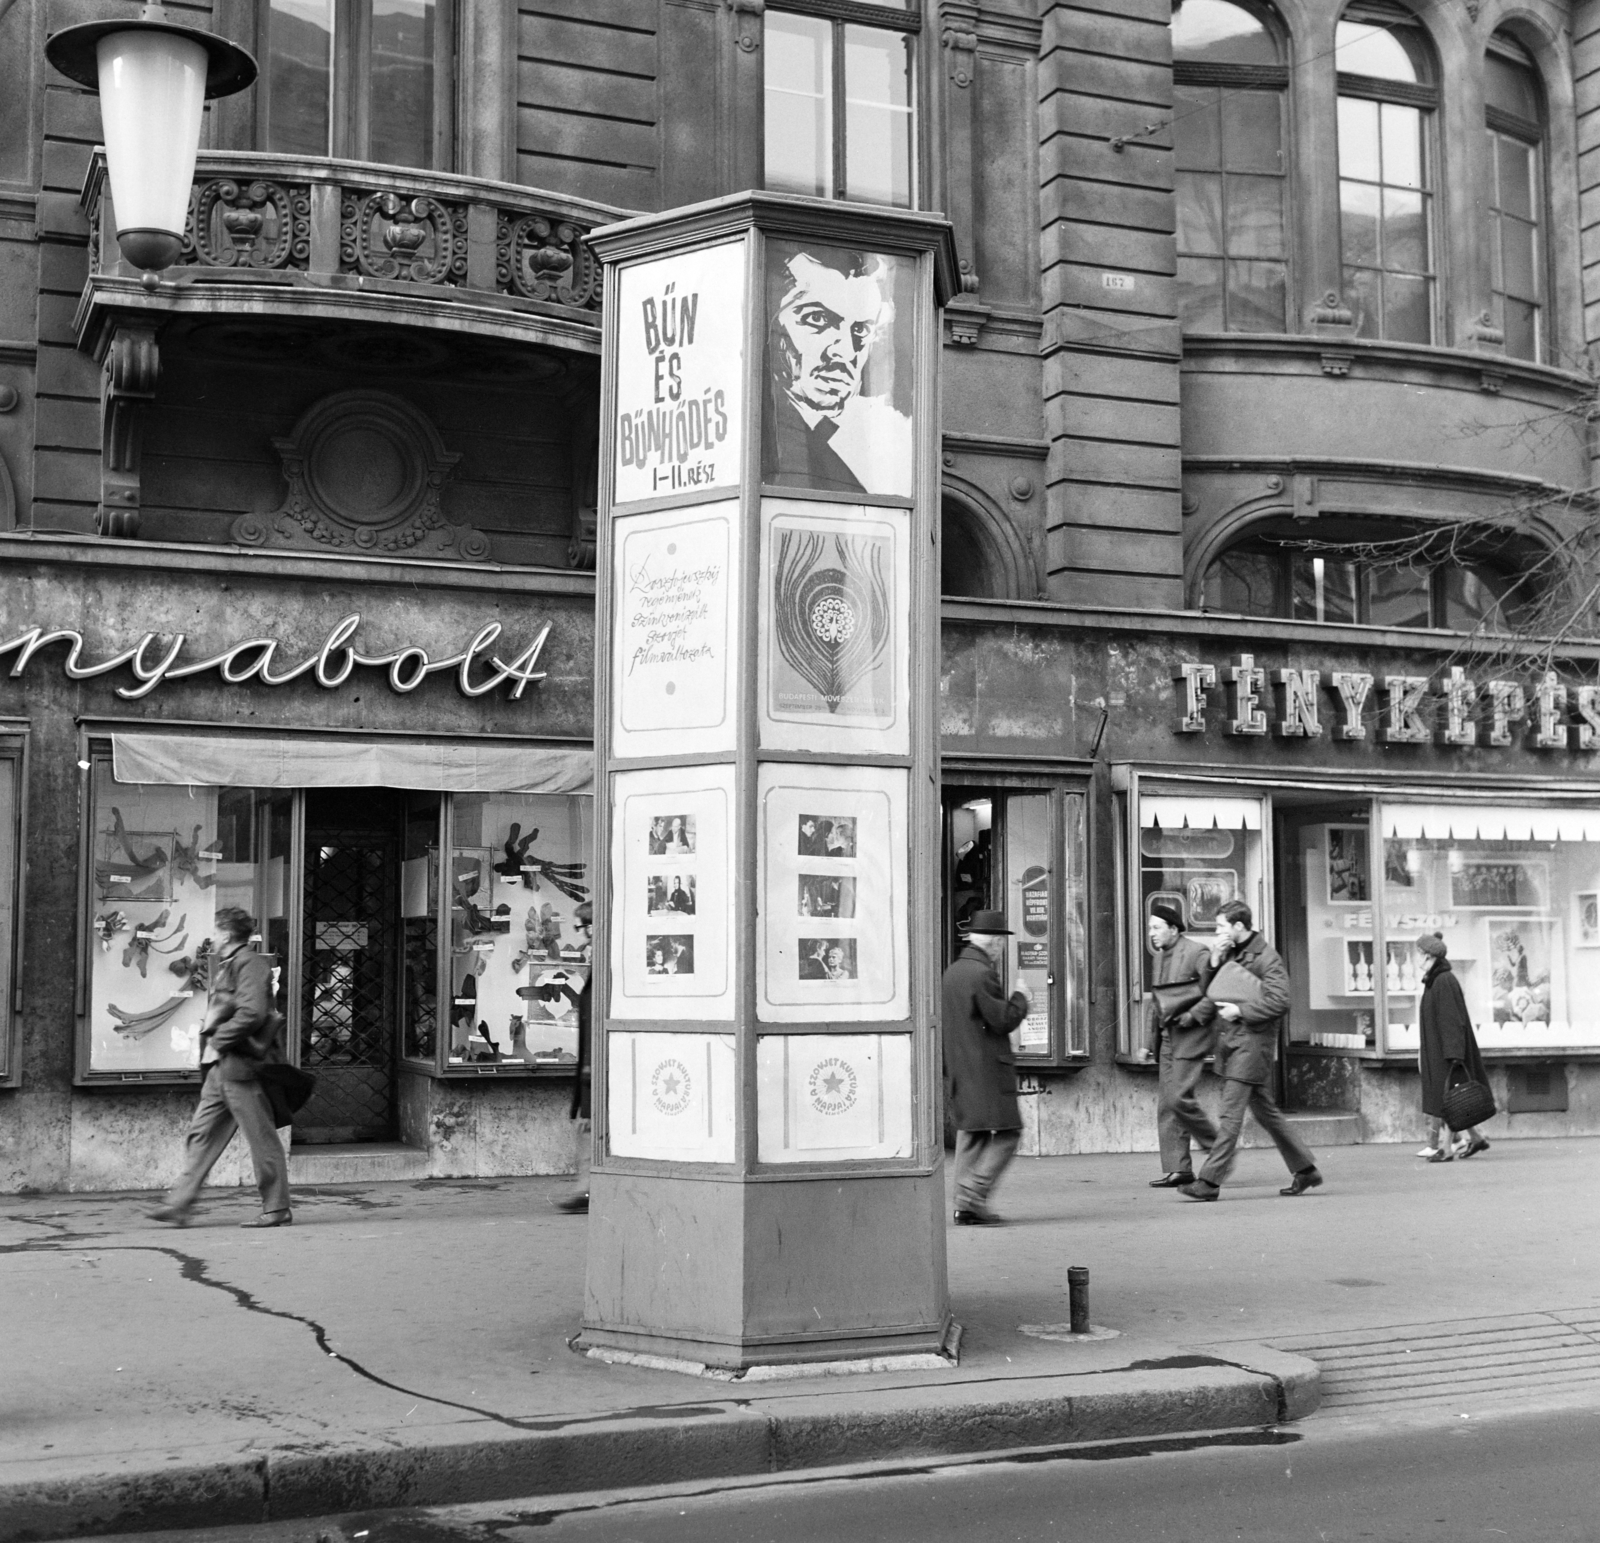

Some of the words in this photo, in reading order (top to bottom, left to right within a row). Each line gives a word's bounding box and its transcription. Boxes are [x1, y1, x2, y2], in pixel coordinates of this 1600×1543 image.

[641, 281, 699, 355] BŰN
[653, 346, 682, 404] ÉS
[620, 387, 728, 470] BŰNHŐDÉS
[778, 692, 817, 701] BUDAPESTI
[651, 1058, 677, 1086] SZOVJET
[809, 1058, 840, 1086] SZOVJET
[839, 1060, 858, 1102] KULTÚRA
[656, 1097, 682, 1112] NAPJAI
[810, 1088, 818, 1096] A
[814, 1096, 847, 1112] NAPJAI
